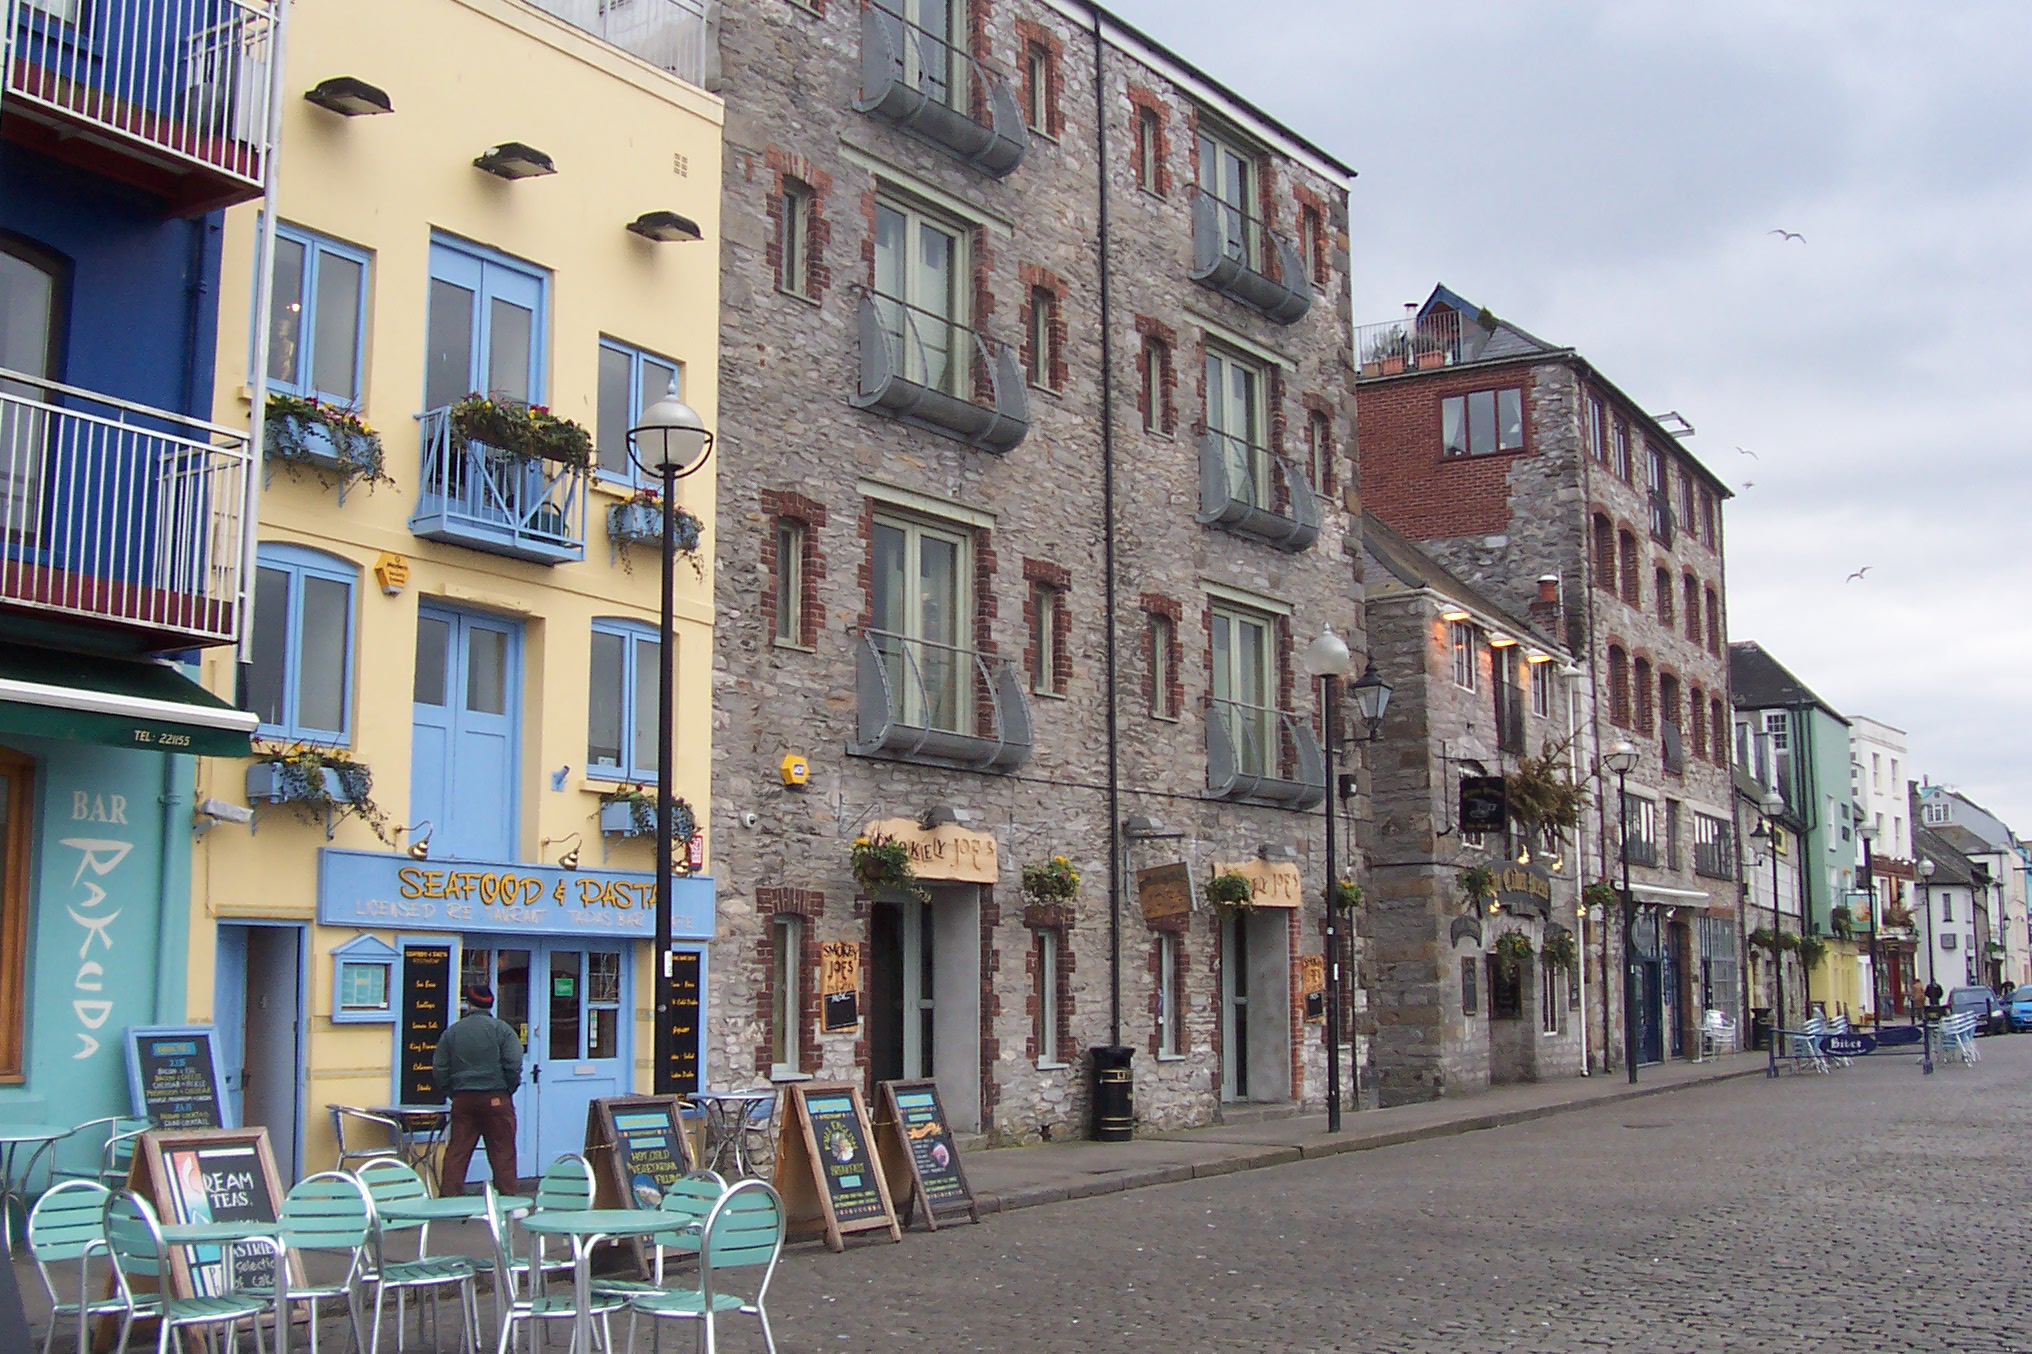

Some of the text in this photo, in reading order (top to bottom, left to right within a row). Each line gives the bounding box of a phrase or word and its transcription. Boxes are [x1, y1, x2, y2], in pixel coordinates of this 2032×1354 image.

[72, 790, 128, 824] BAR
[398, 867, 545, 906] SEAFOOD
[553, 879, 567, 907] &
